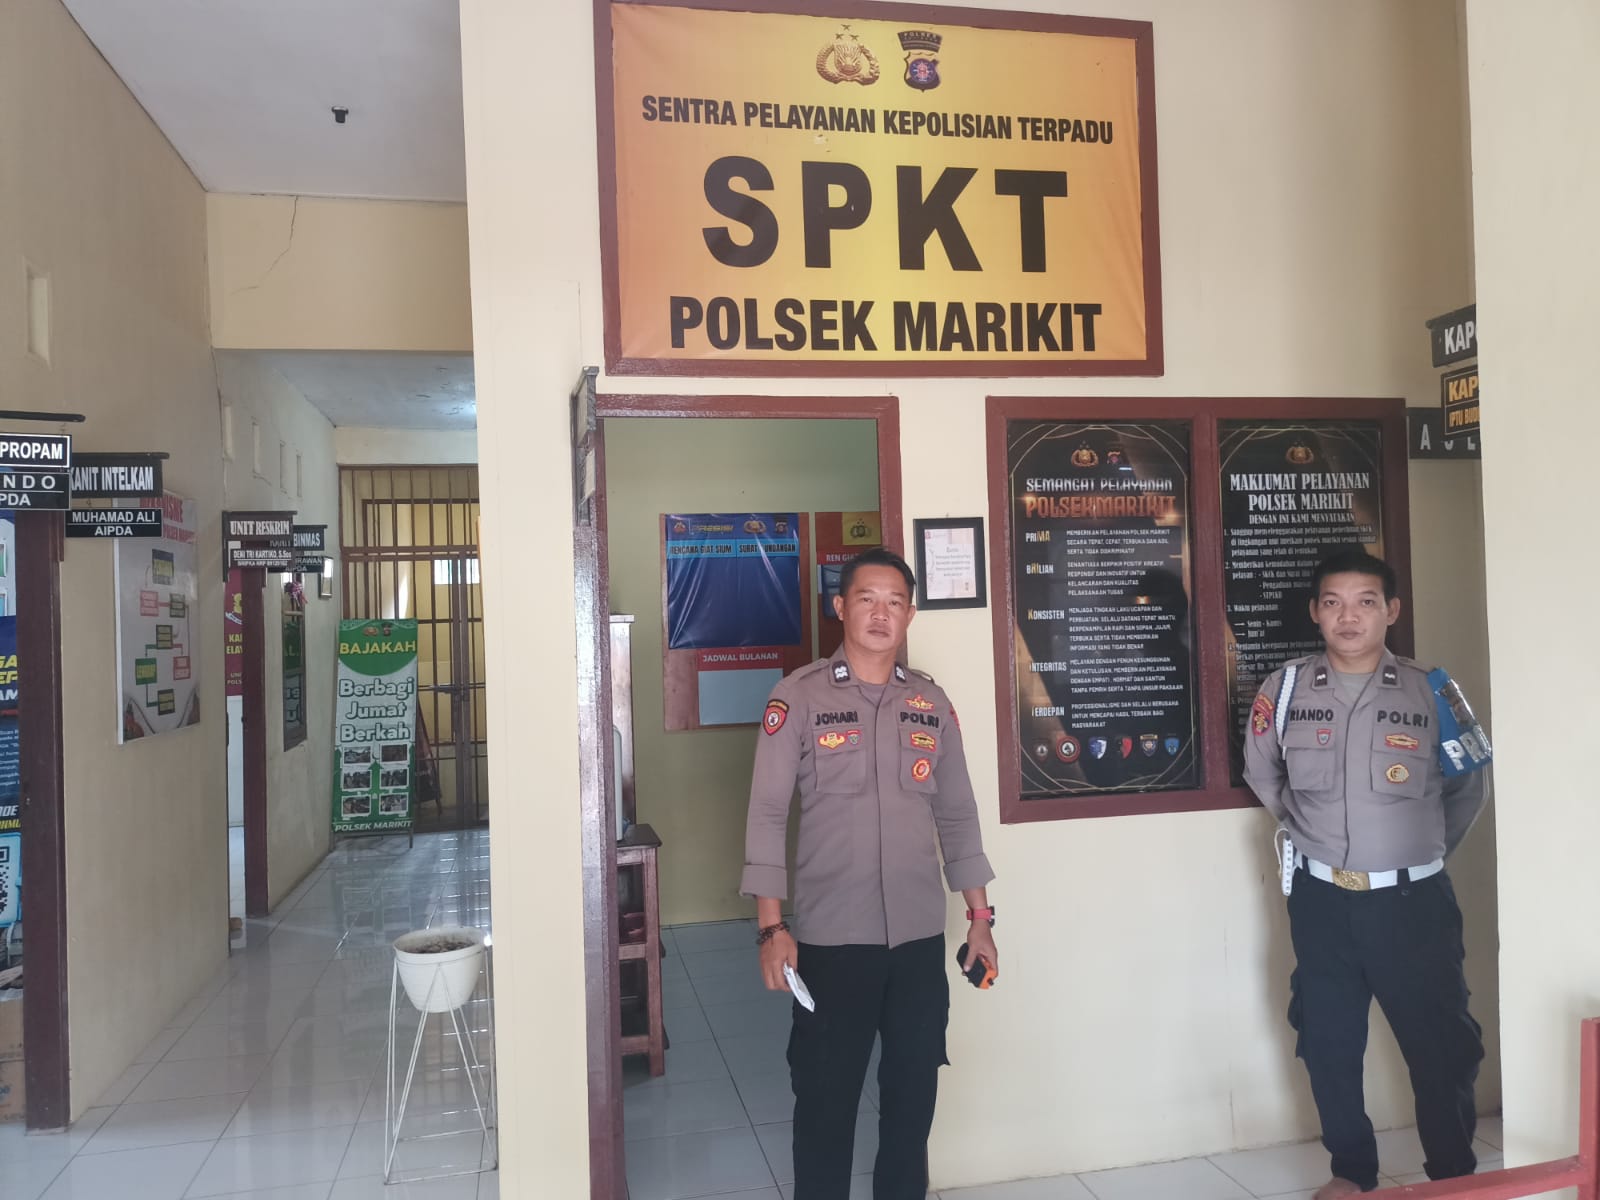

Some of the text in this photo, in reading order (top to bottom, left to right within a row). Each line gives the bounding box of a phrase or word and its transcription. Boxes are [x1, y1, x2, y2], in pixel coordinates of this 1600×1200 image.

[642, 95, 1113, 145] SENTRA PELAYANAN KEPOLISIAN TERPADU
[702, 155, 1068, 274] SPKT
[670, 296, 1102, 353] POLSEK MARIKIT
[1444, 320, 1478, 355] KAP
[0, 441, 63, 460] PROPAM
[101, 466, 154, 491] INTELKAM
[1026, 478, 1096, 493] SEMANGAT
[1230, 472, 1370, 491] MAKLUMAT PELAYANAN
[1025, 496, 1092, 518] POLSEK
[1248, 492, 1354, 511] POLSEK MARIKIT
[72, 511, 155, 522] MUHAMAD ALI
[1249, 514, 1277, 525] DENGAN
[1279, 513, 1289, 524] INI
[1291, 513, 1309, 524] KAMI
[94, 526, 133, 536] AIPDA
[230, 520, 290, 535] UNIT RESKRIM
[293, 532, 320, 547] BINMAS
[715, 545, 732, 554] SIUM
[1028, 609, 1065, 621] KONSISTEN
[339, 640, 416, 655] BAJAKAH
[703, 651, 778, 662] JADWAL BULANAN
[339, 677, 414, 700] Berbagi
[346, 701, 407, 719] Jumat
[815, 711, 859, 726] JOHARI
[1289, 708, 1334, 722] RIANDO
[900, 711, 939, 729] POLRI
[1376, 710, 1429, 729] POLRI
[340, 723, 410, 742] Berkah
[335, 820, 412, 832] POLSEK MARIKIT
